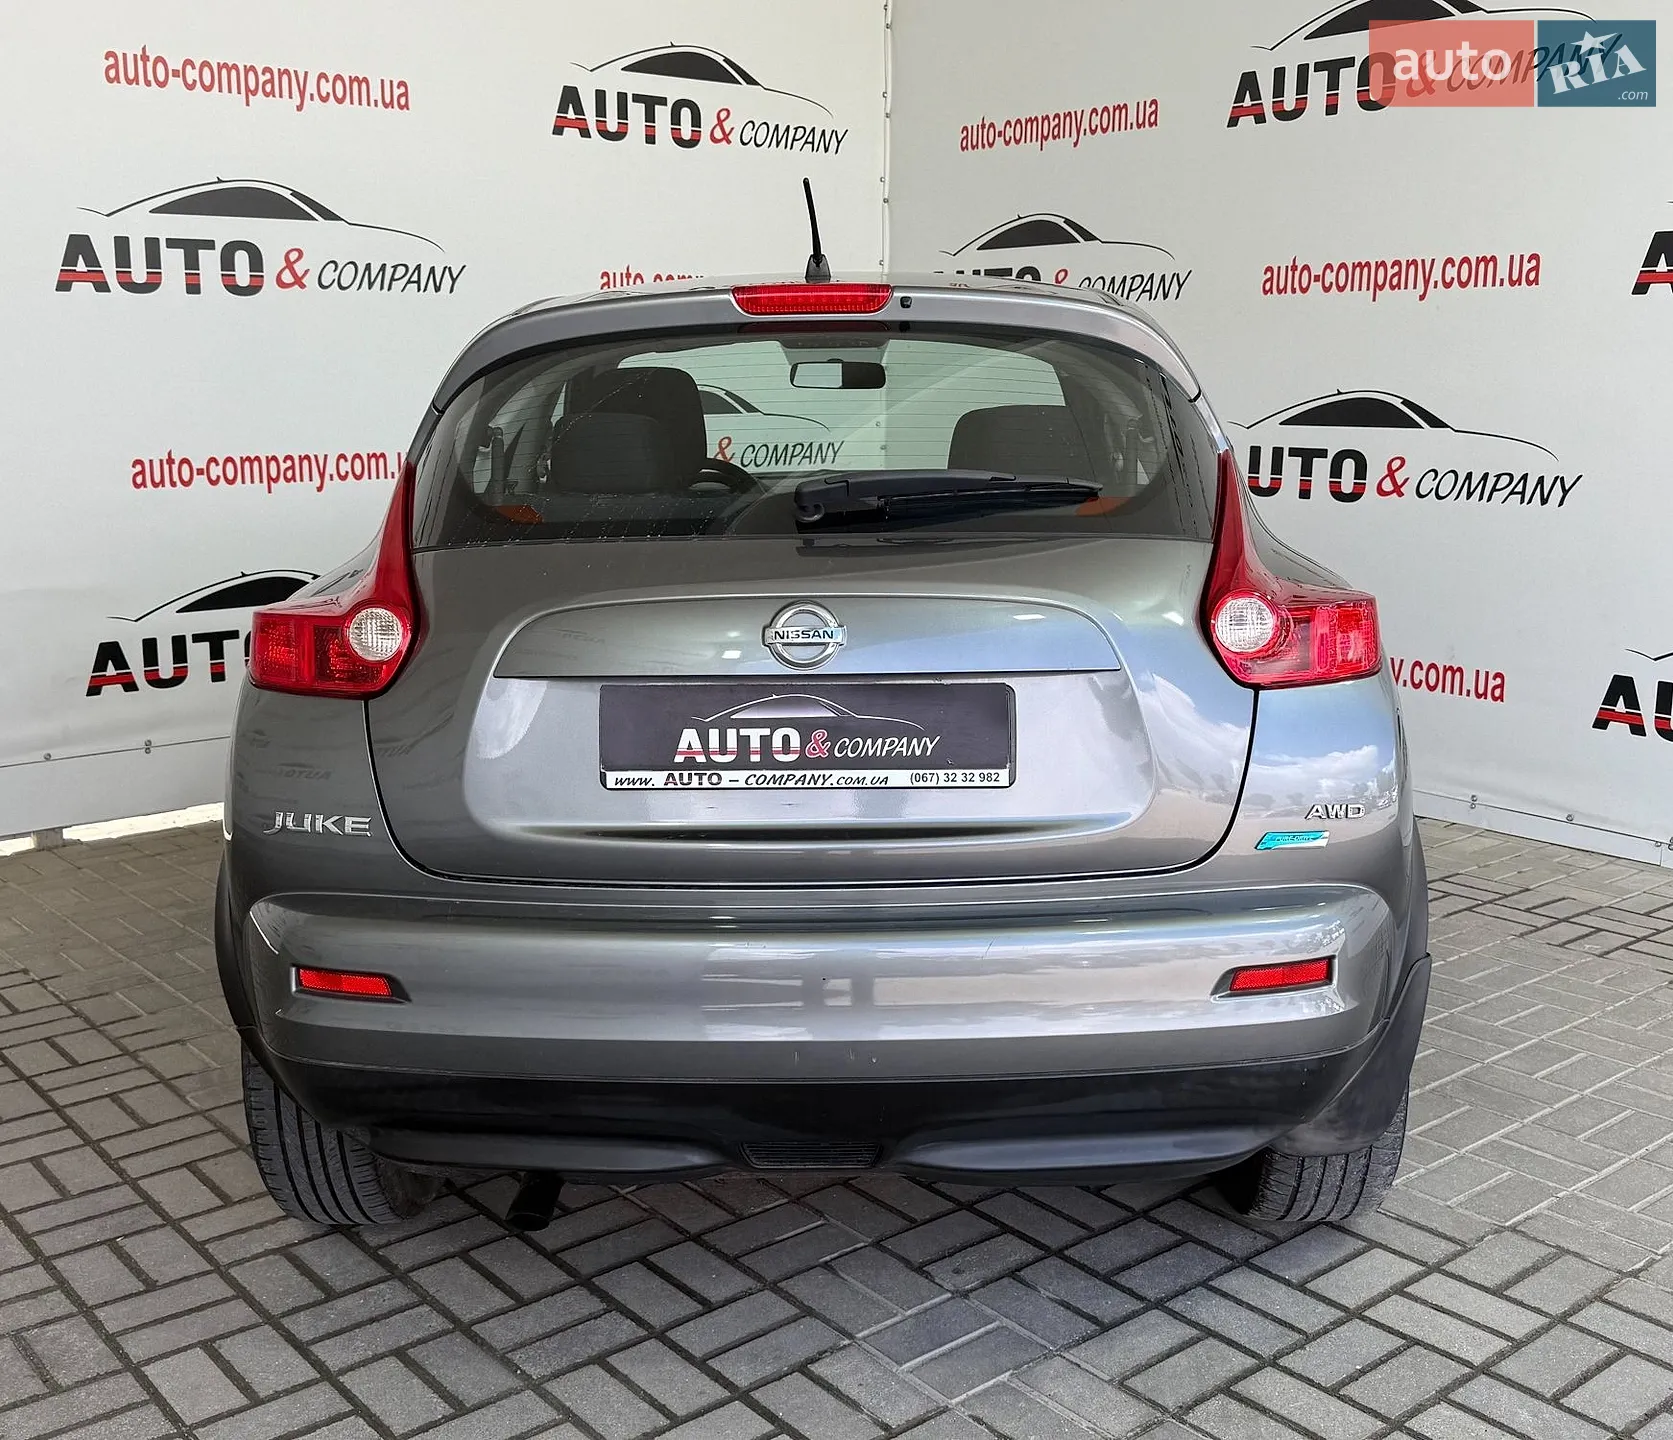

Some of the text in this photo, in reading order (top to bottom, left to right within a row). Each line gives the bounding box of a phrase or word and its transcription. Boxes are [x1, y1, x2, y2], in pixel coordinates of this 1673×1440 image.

[104, 45, 410, 112] auto-company.com.ua
[1226, 51, 1396, 128] AUTO
[552, 85, 848, 155] AUTO & COMPANY
[960, 98, 1159, 152] auto-company.com.ua
[55, 233, 466, 297] AUTO & COMPANY
[1261, 251, 1541, 302] auto-company.com.ua
[740, 440, 845, 468] COMPANY
[1376, 456, 1411, 499] &
[1415, 468, 1584, 508] COMPANY
[774, 629, 834, 640] NISSAN
[85, 630, 254, 697] AUT
[673, 727, 941, 763] AUTO & COMPANY
[664, 772, 722, 787] AUTO
[910, 772, 940, 785] (067)
[943, 772, 957, 783] 32
[961, 772, 975, 783] 32
[978, 771, 1000, 782] 982
[262, 811, 372, 837] JUKE
[1305, 804, 1366, 820] AWD
